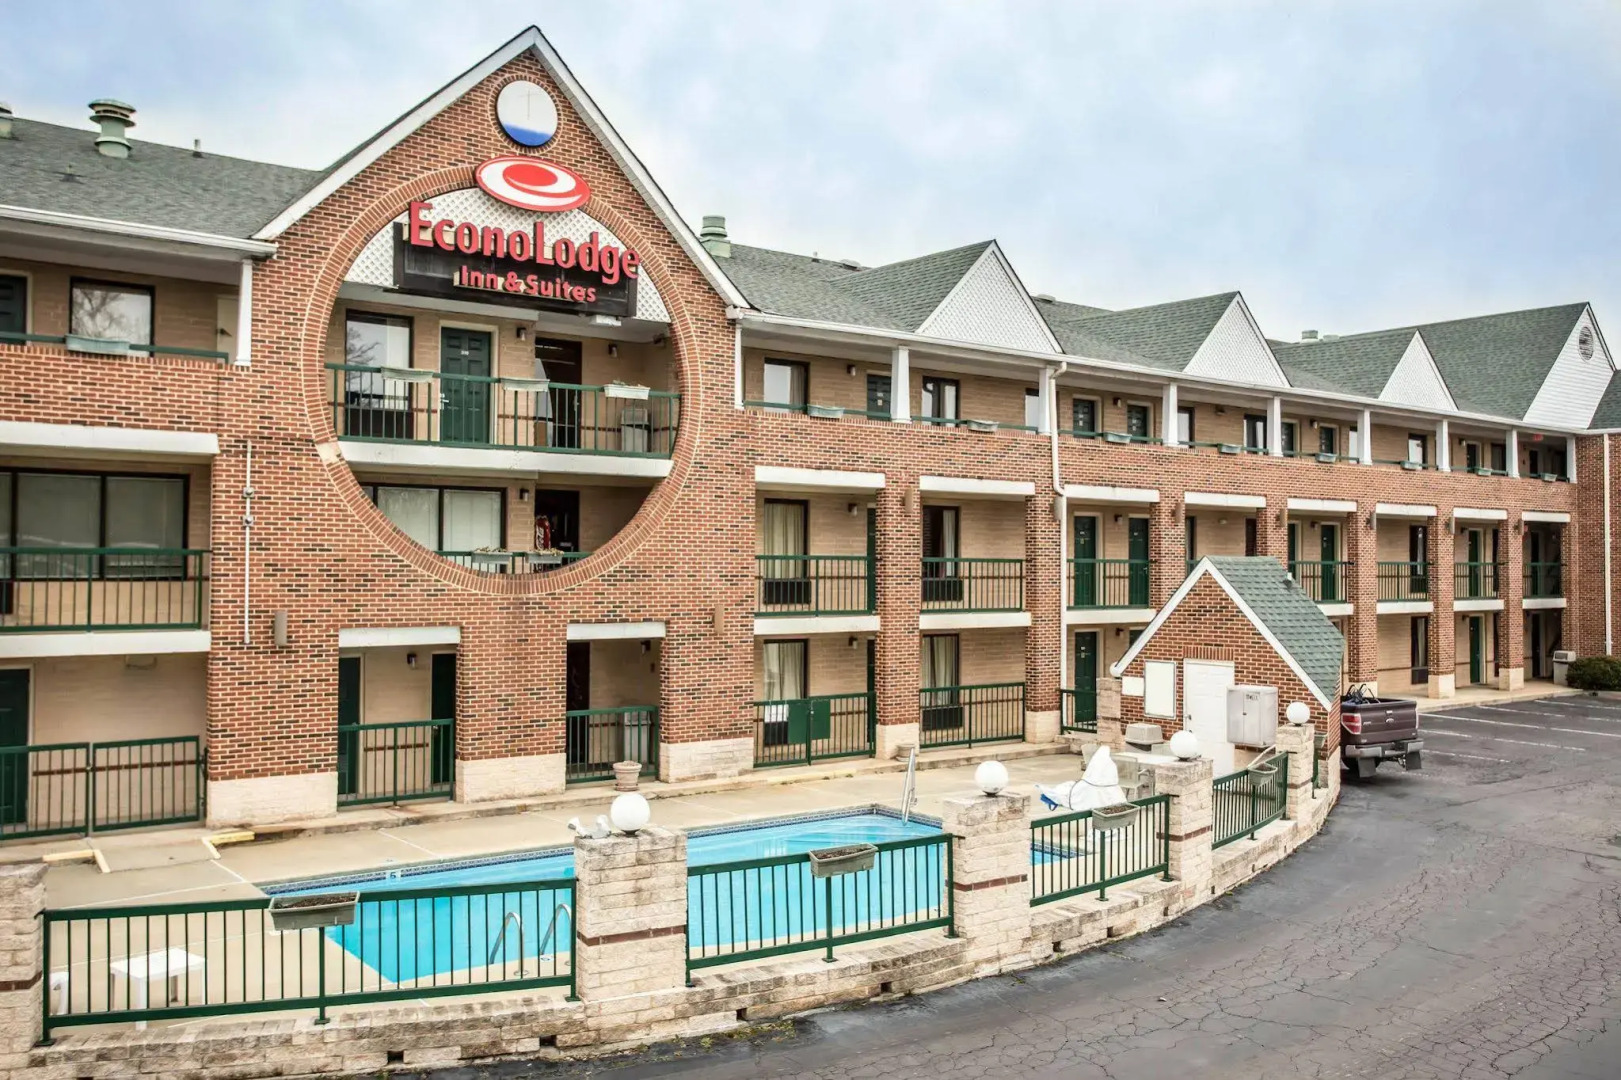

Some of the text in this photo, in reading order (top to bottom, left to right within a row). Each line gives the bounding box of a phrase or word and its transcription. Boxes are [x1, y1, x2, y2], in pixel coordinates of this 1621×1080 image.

[409, 202, 640, 284] EconoLodge
[461, 265, 597, 303] Inn & Suites
